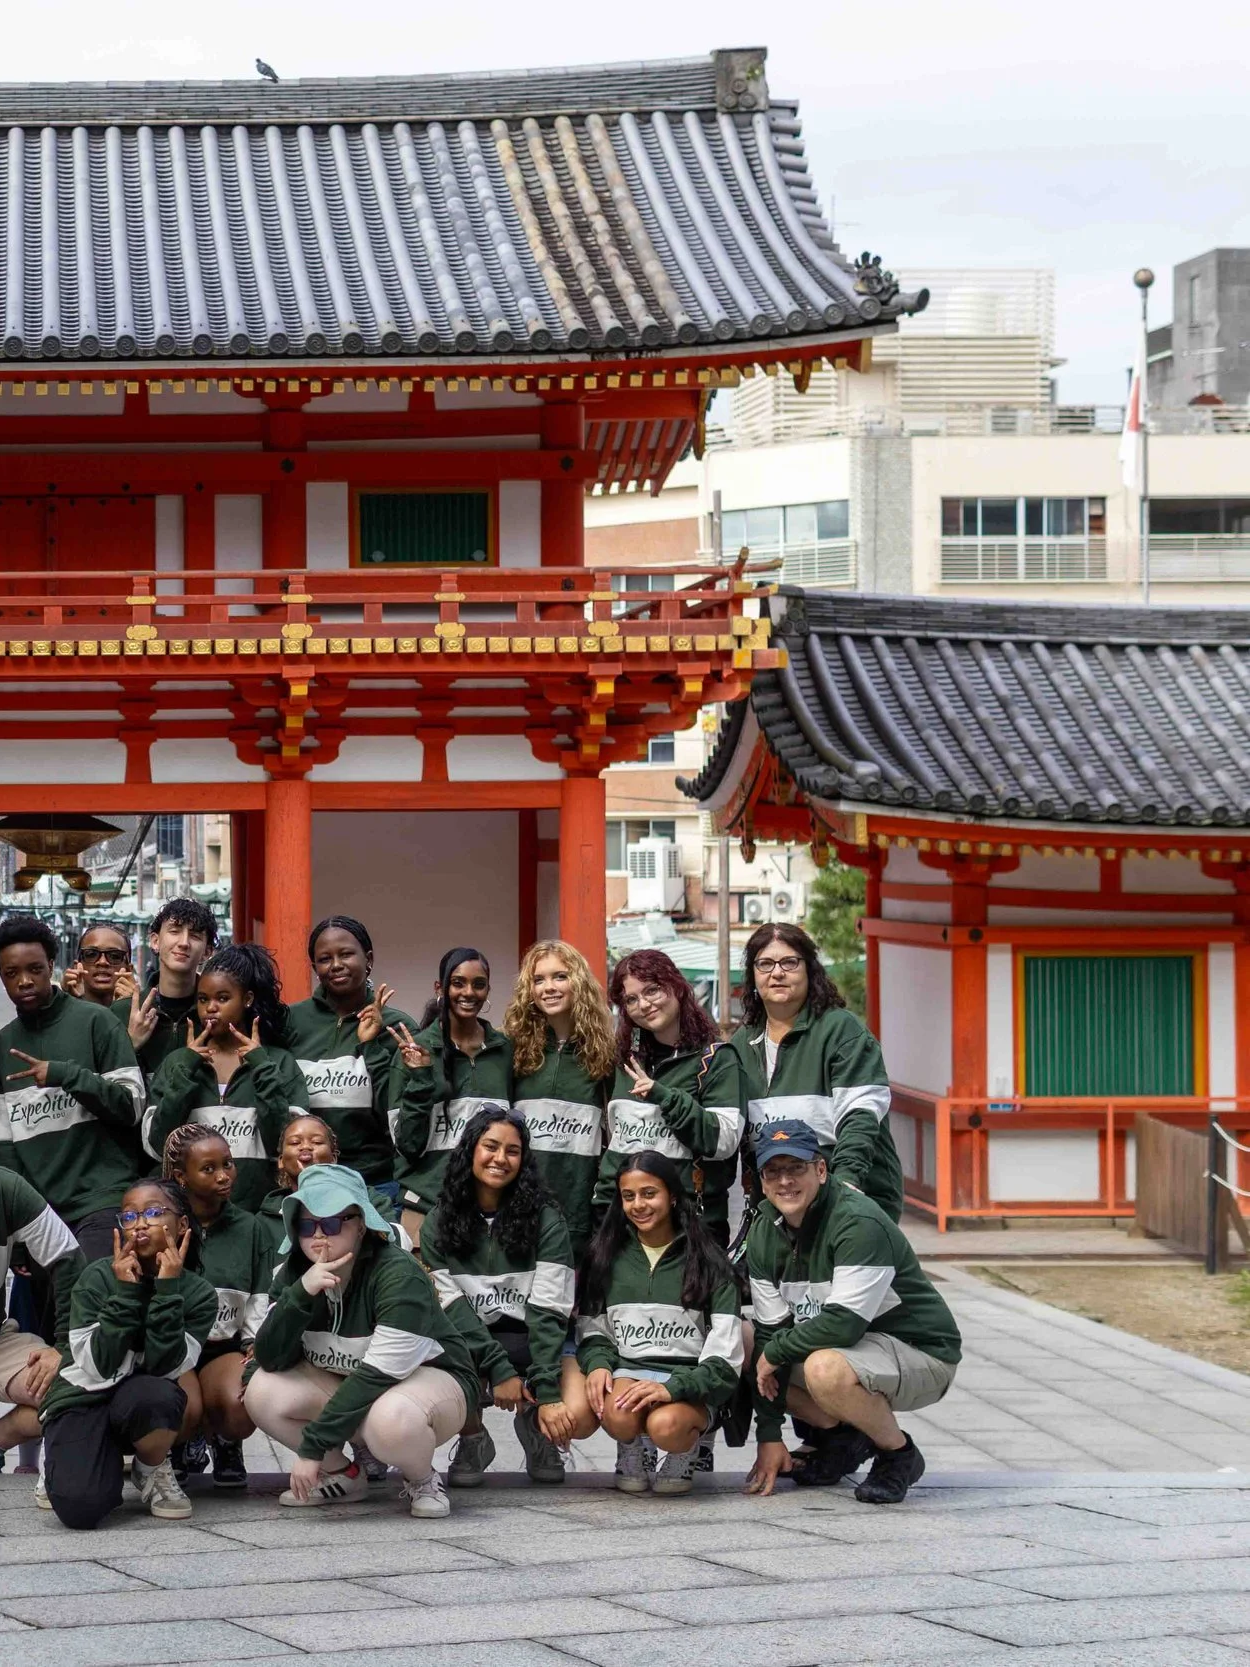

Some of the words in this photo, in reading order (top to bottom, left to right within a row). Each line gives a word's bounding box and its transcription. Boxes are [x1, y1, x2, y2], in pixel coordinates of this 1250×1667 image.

[306, 1068, 368, 1088] pedition
[10, 1093, 77, 1125] Expeditio
[613, 1317, 697, 1346] Expedition
